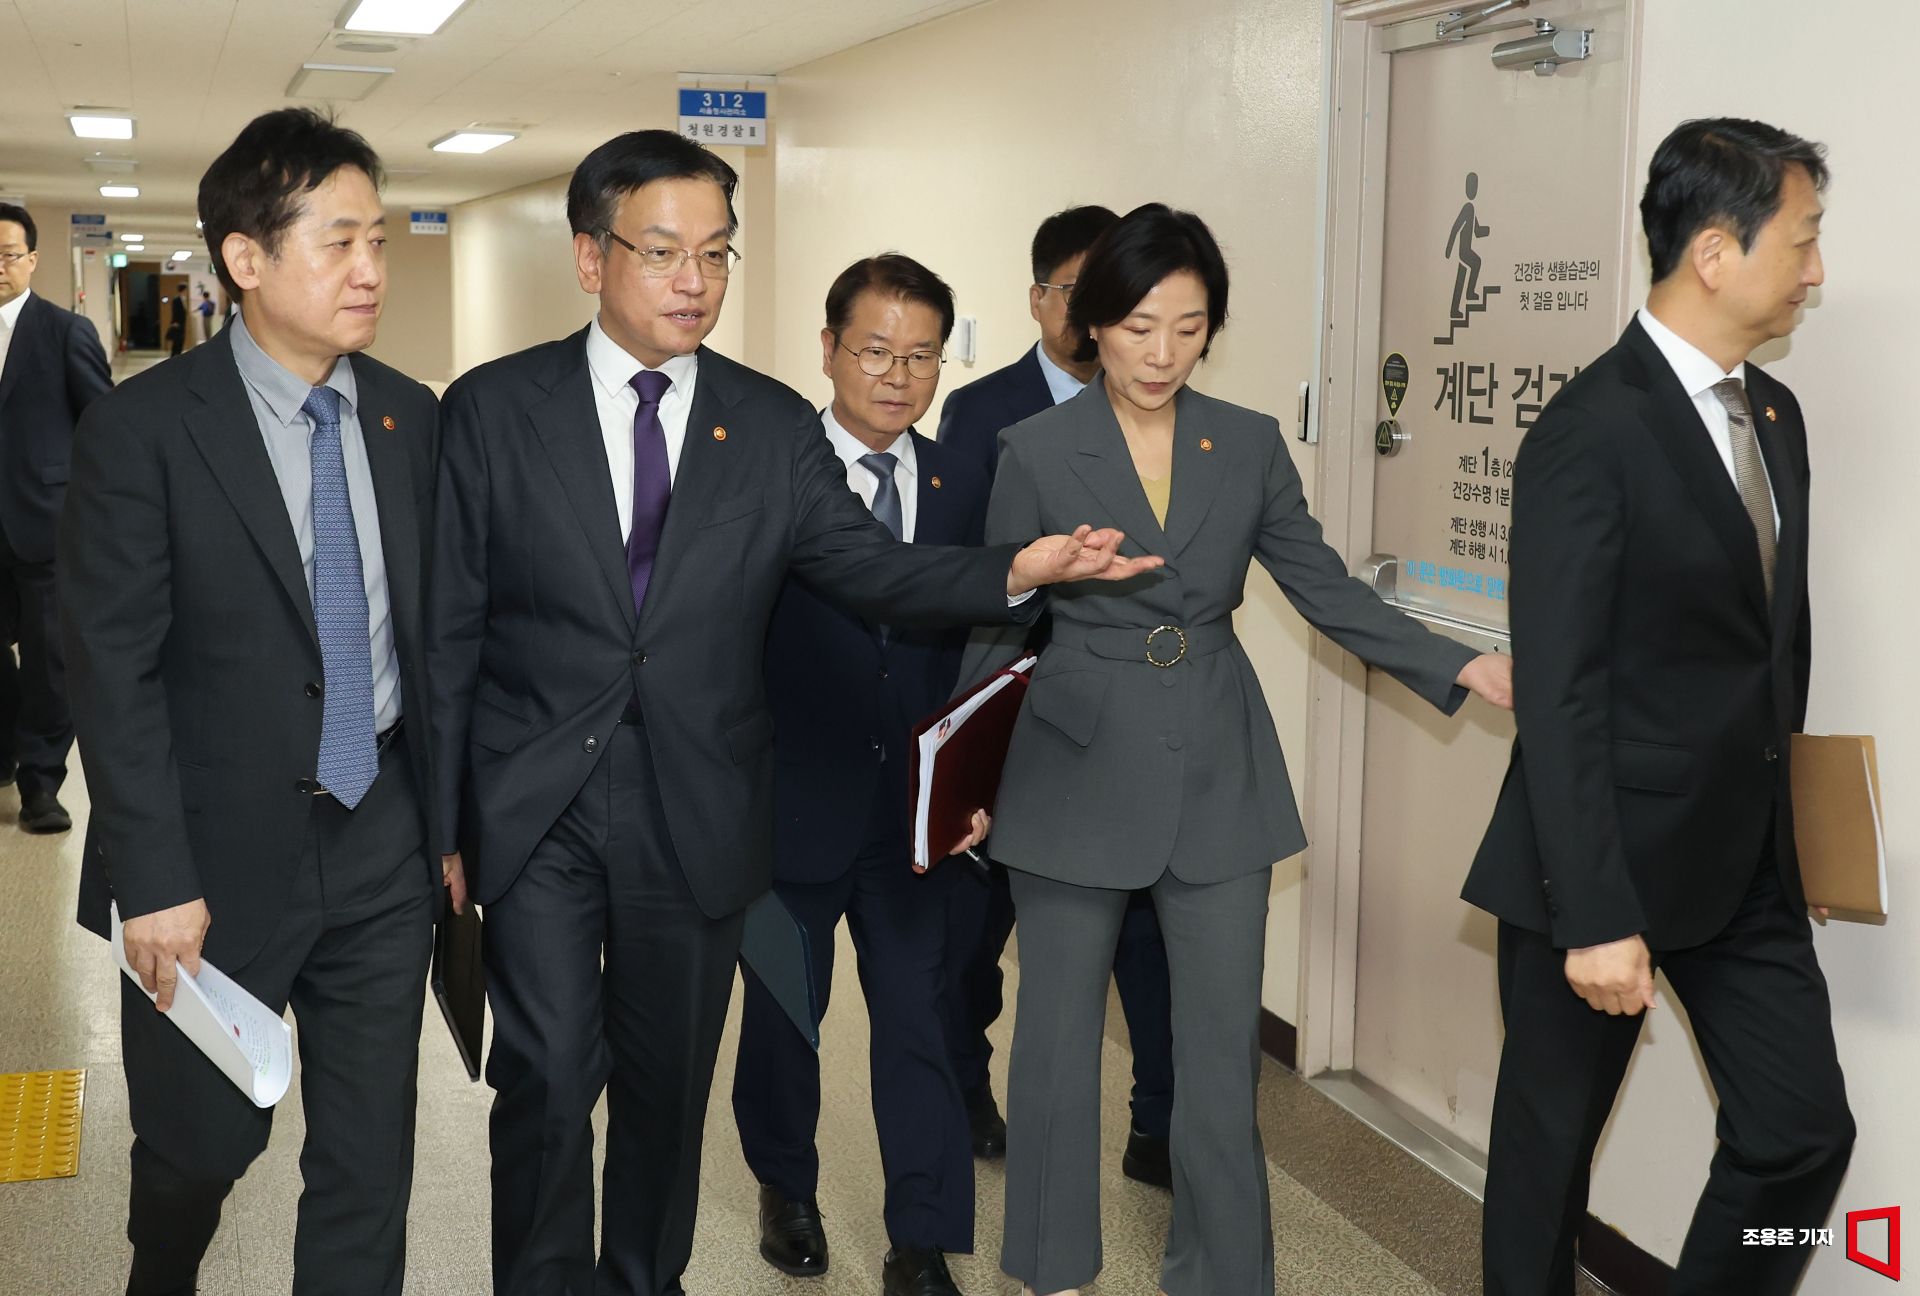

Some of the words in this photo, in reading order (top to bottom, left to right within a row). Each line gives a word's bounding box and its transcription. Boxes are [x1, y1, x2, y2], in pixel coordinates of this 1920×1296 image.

[702, 92, 744, 108] 312
[1514, 261, 1544, 282] 건강한
[1547, 259, 1601, 281] 생활습관의
[1519, 291, 1530, 311] 첫
[1533, 291, 1554, 311] 걸음
[1556, 290, 1589, 311] 입니다
[1434, 361, 1499, 424] 계단
[1458, 455, 1478, 474] 계단
[1452, 481, 1492, 505] 건강수명
[1450, 516, 1468, 535] 계단
[1469, 519, 1487, 538] 상행
[1489, 522, 1498, 541] 시
[1449, 538, 1467, 556] 계단
[1468, 541, 1486, 560] 하행
[1488, 545, 1497, 563] 시
